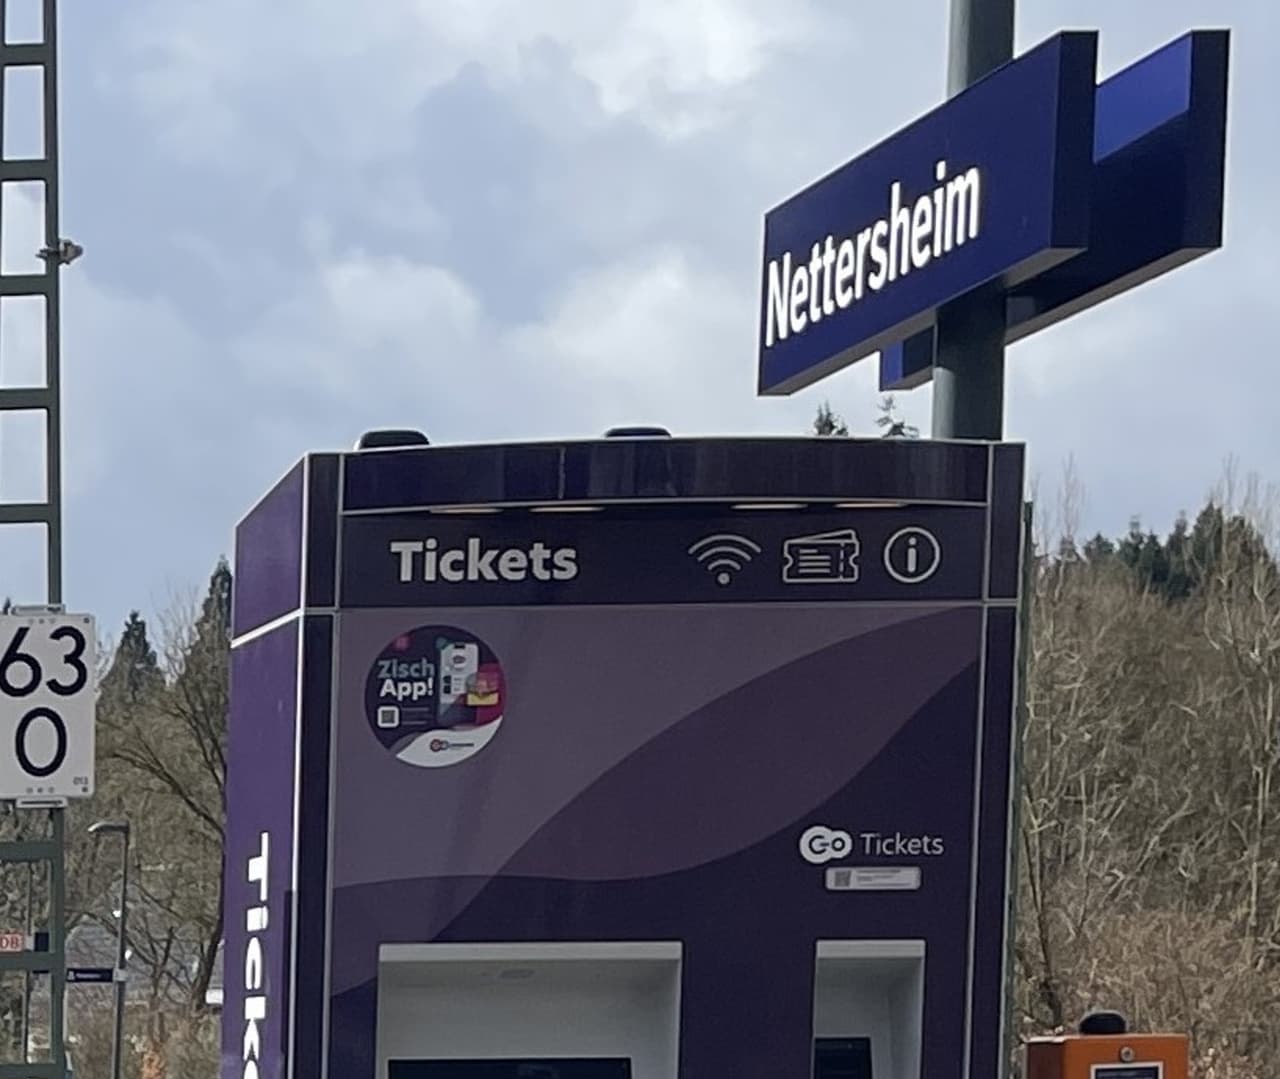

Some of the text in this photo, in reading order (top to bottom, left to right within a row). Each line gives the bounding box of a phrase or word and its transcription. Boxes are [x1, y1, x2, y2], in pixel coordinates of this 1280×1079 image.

[765, 160, 980, 347] Nettersheim
[390, 537, 579, 583] Tickets
[378, 657, 436, 678] Zisch
[380, 677, 434, 701] App!
[15, 706, 68, 777] 0
[860, 831, 945, 856] Tickets
